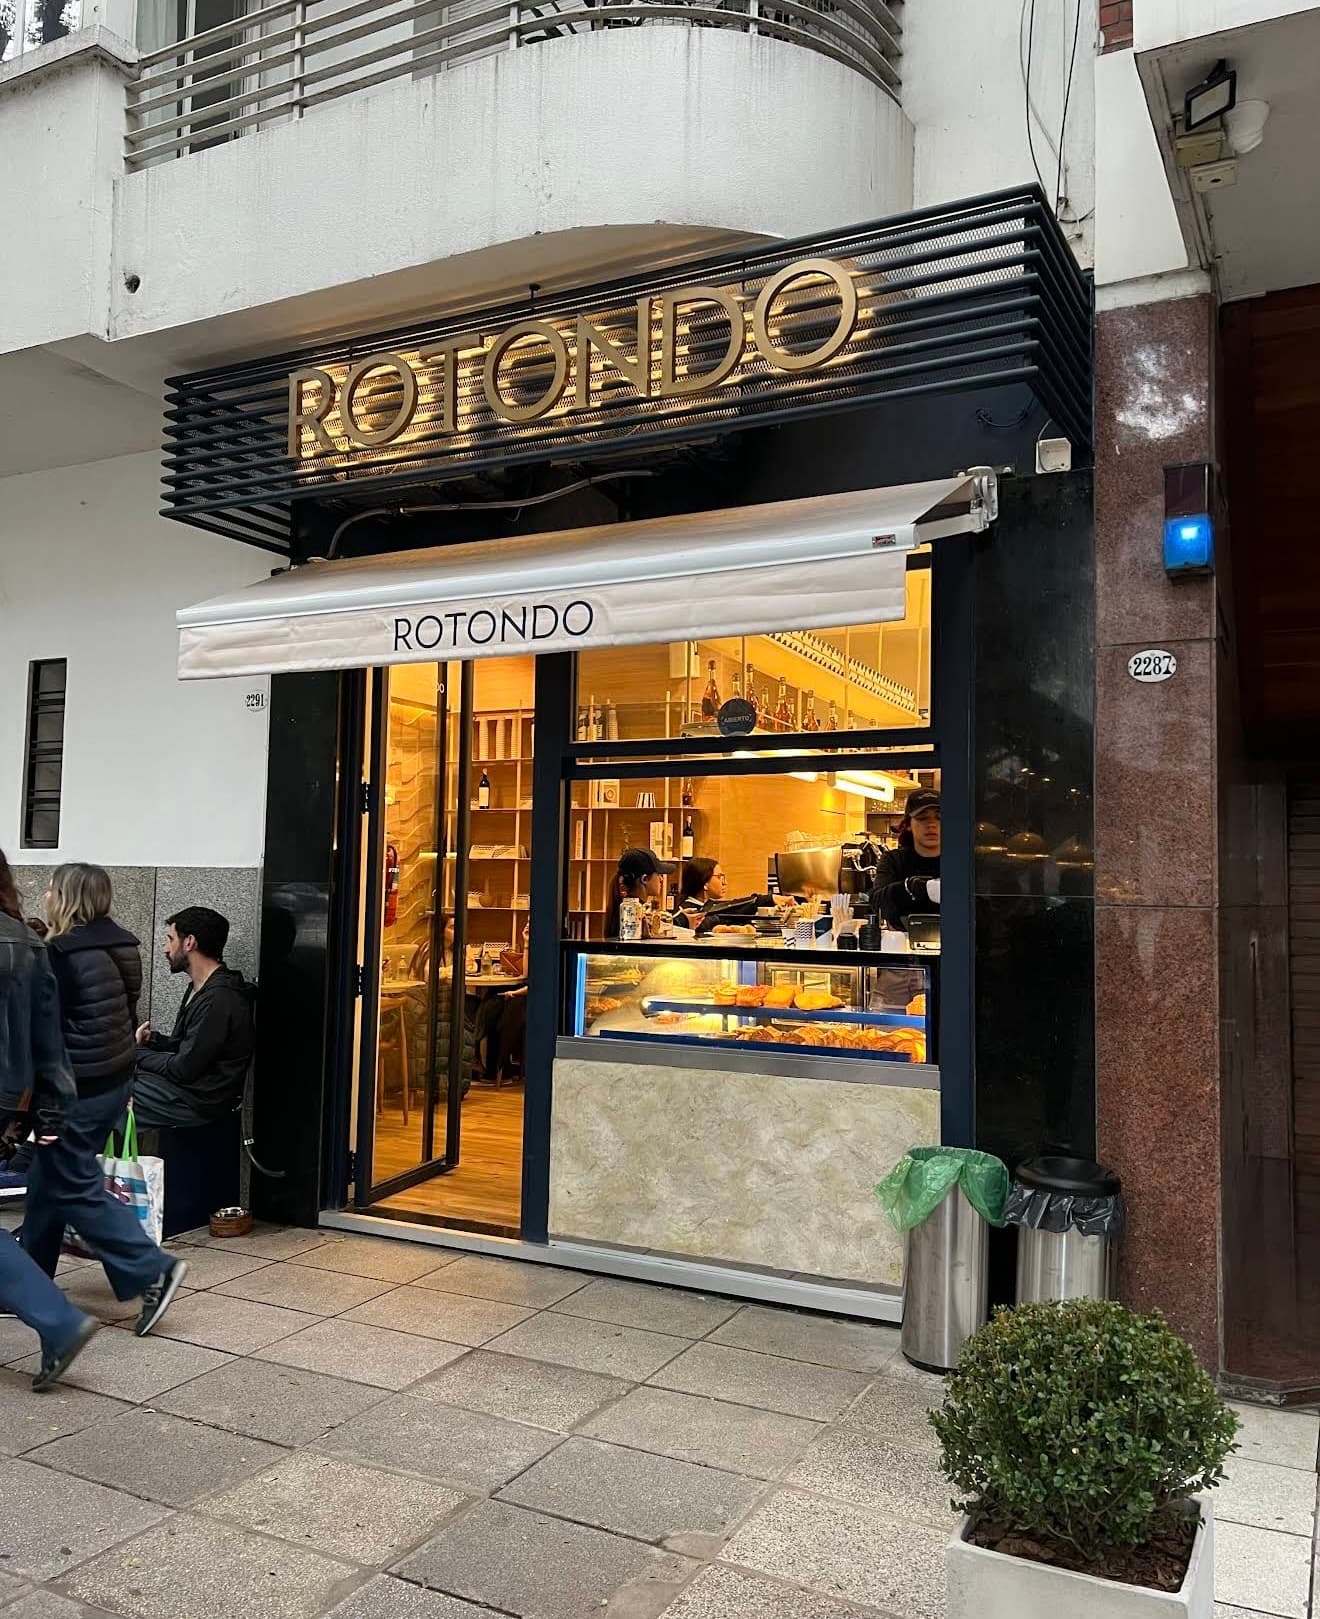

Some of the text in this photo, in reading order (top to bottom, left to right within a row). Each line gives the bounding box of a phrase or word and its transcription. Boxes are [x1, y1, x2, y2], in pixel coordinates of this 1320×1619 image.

[288, 257, 858, 458] ROTONDO
[394, 600, 594, 650] ROTONDO
[1134, 656, 1172, 676] 2287
[246, 693, 264, 707] 2291
